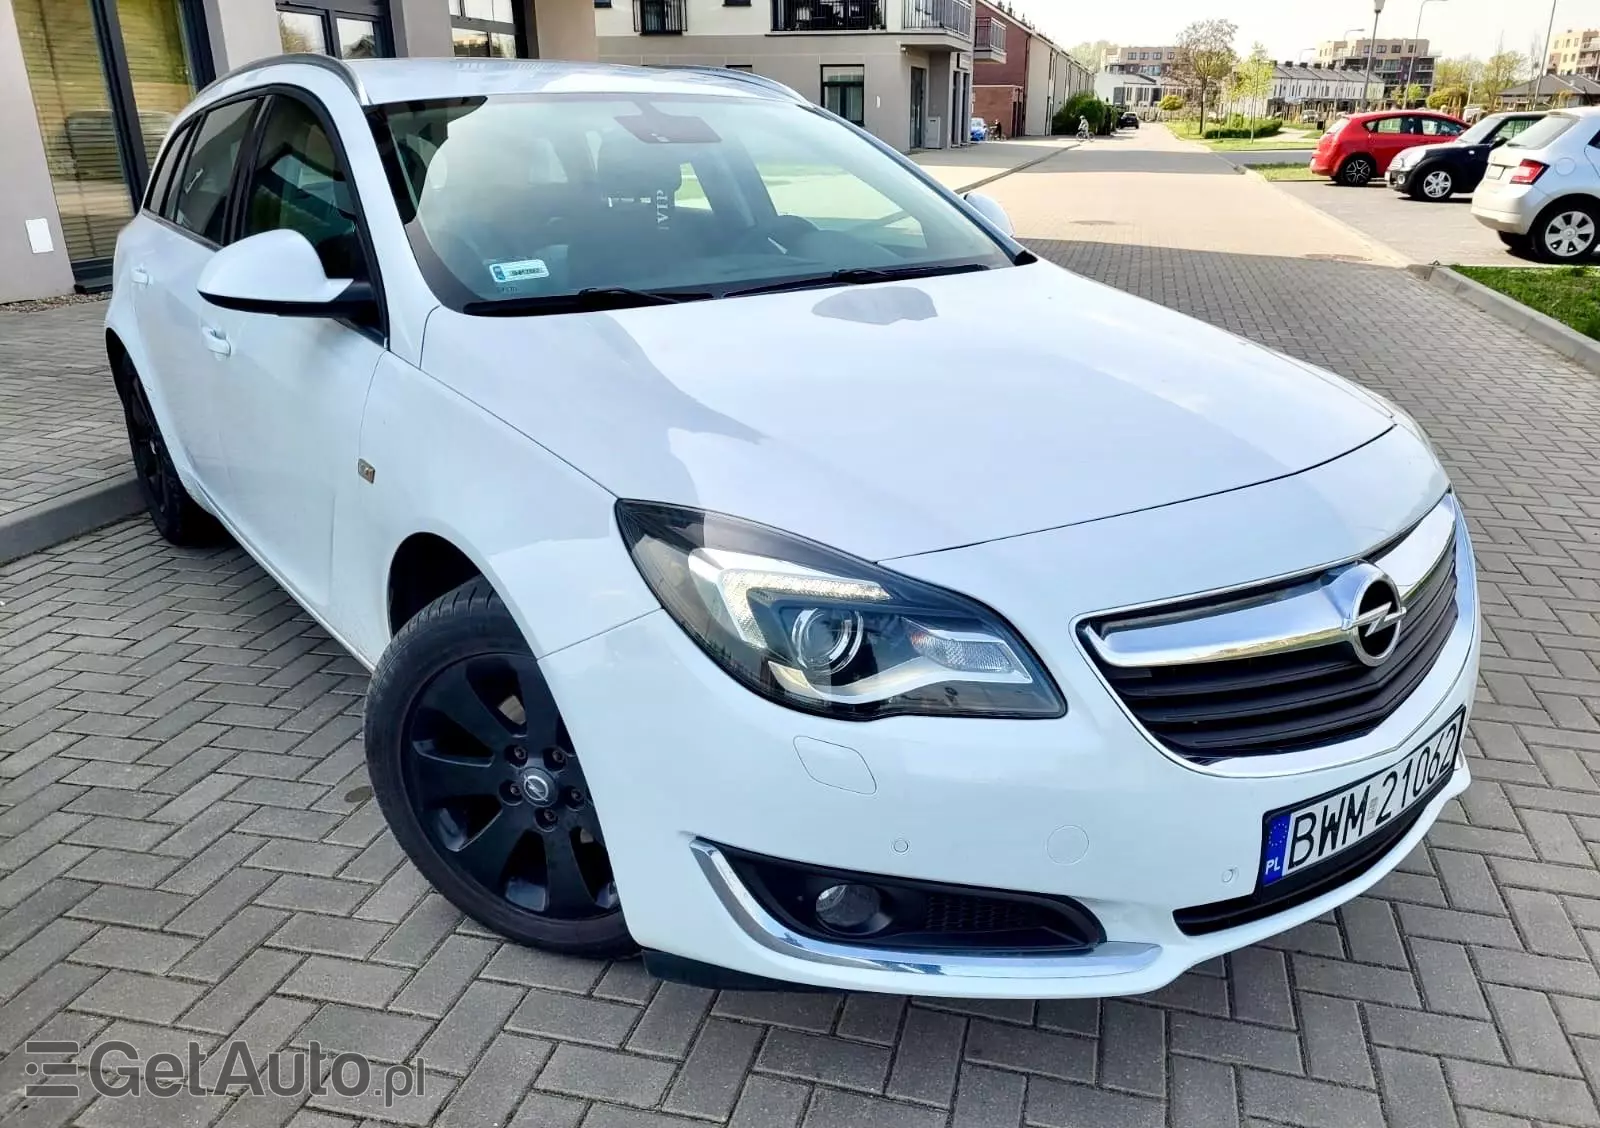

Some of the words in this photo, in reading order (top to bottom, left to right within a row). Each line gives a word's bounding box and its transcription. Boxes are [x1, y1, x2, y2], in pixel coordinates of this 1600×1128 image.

[1287, 784, 1371, 870] BWM
[1375, 723, 1457, 827] 21062
[1264, 856, 1281, 875] PL
